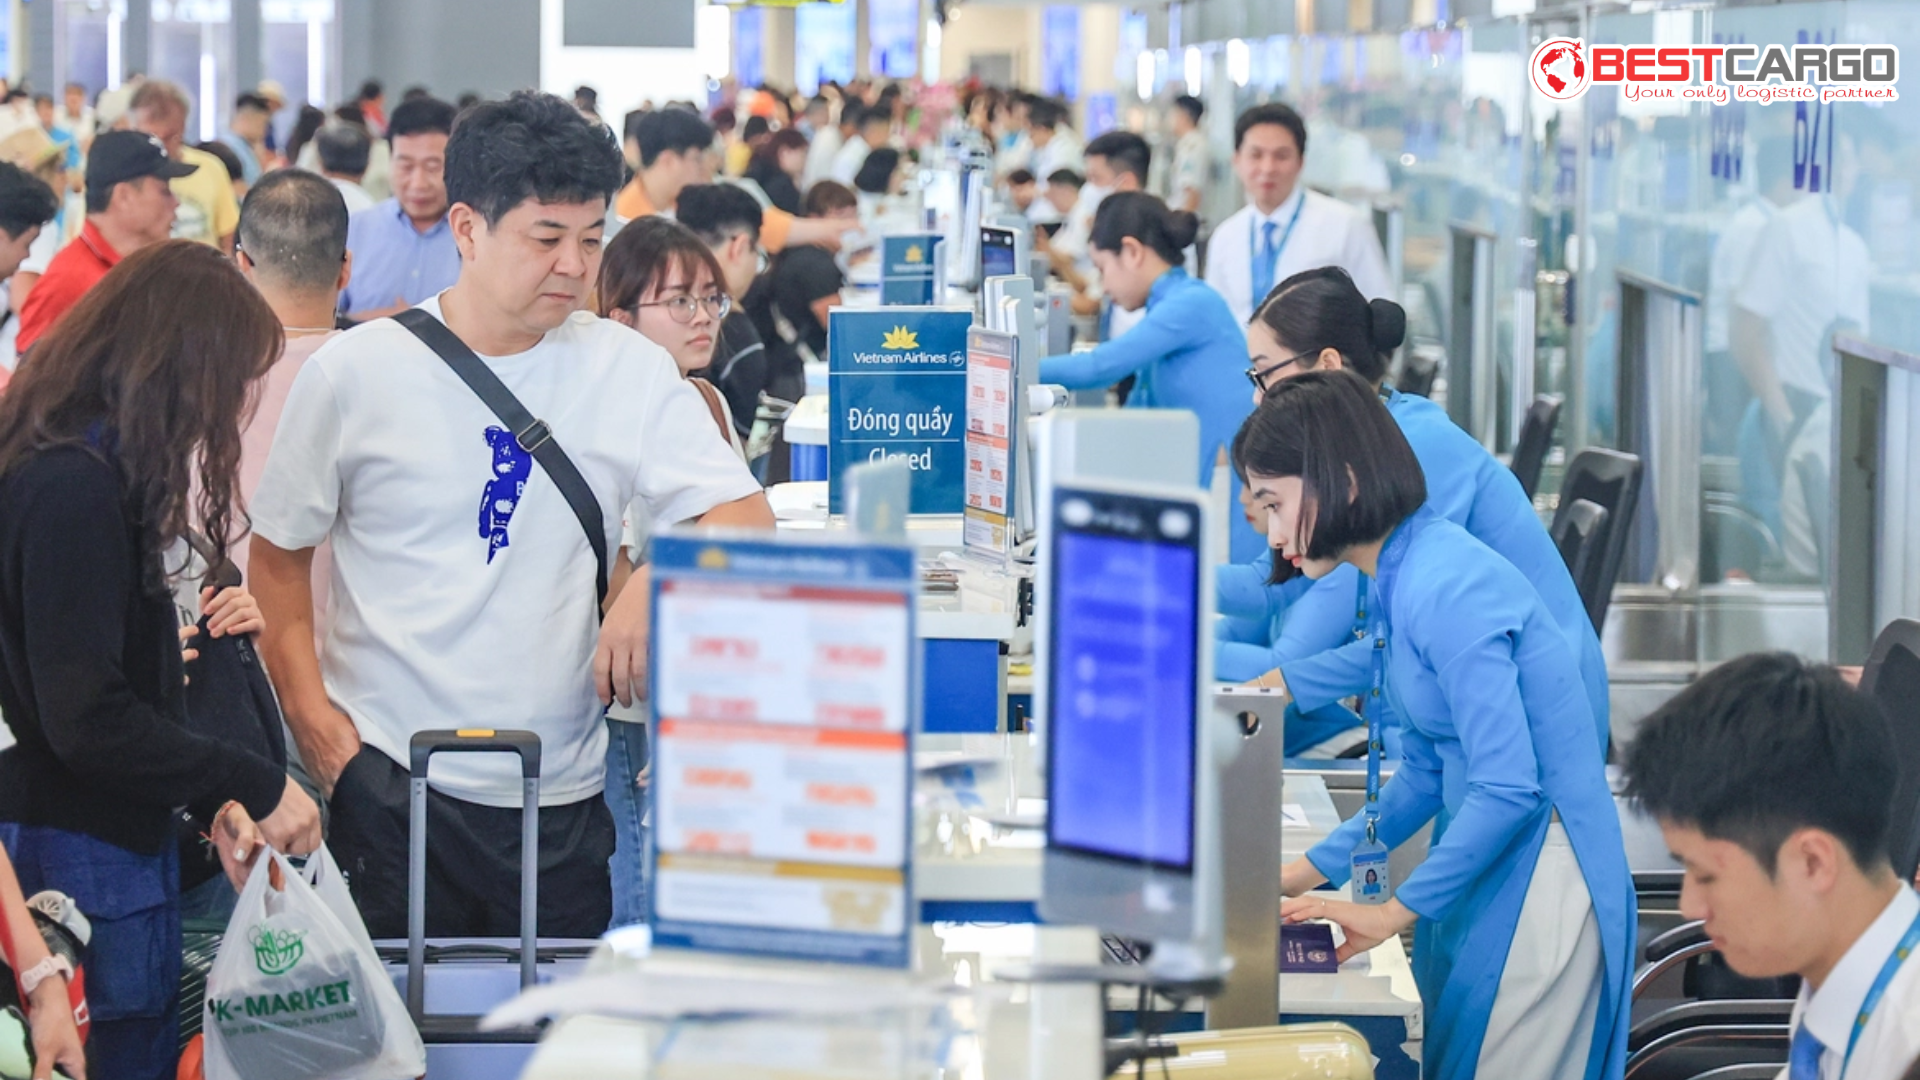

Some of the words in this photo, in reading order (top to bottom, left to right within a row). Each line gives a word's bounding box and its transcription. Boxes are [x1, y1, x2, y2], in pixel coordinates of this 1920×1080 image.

[853, 352, 902, 364] Vietnam
[903, 352, 947, 364] Airlines
[848, 407, 899, 436] Đóng
[869, 447, 931, 470] Cled
[216, 981, 349, 1021] K-MARKET
